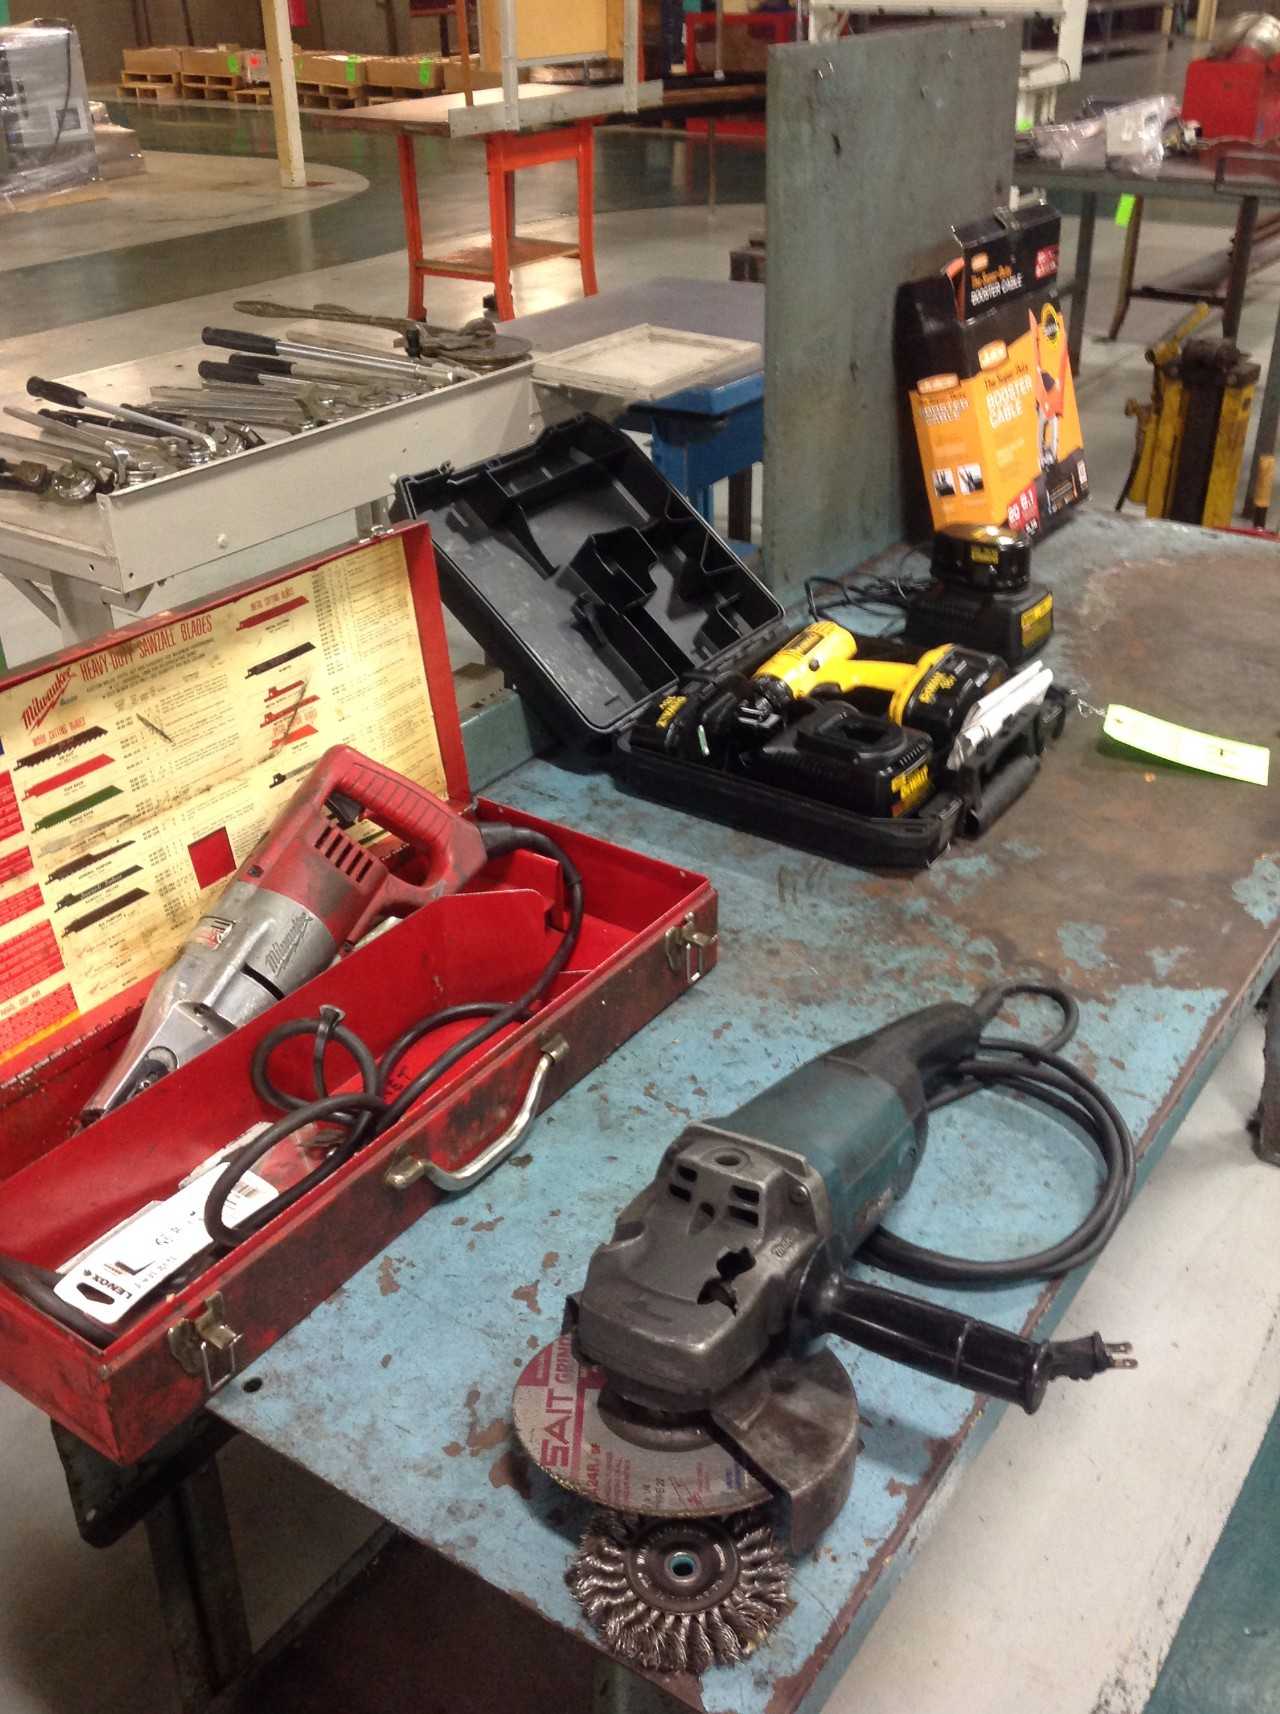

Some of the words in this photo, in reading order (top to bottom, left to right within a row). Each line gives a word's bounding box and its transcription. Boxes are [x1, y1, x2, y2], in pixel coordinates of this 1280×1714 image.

[1000, 272, 1023, 294] CABLE
[986, 374, 1032, 408] BOOSTER
[988, 398, 1023, 429] CABLE
[137, 629, 176, 659] SAWZALL
[180, 615, 212, 642] BLADES
[93, 1274, 133, 1300] LENOX
[540, 1388, 574, 1468] SAIT
